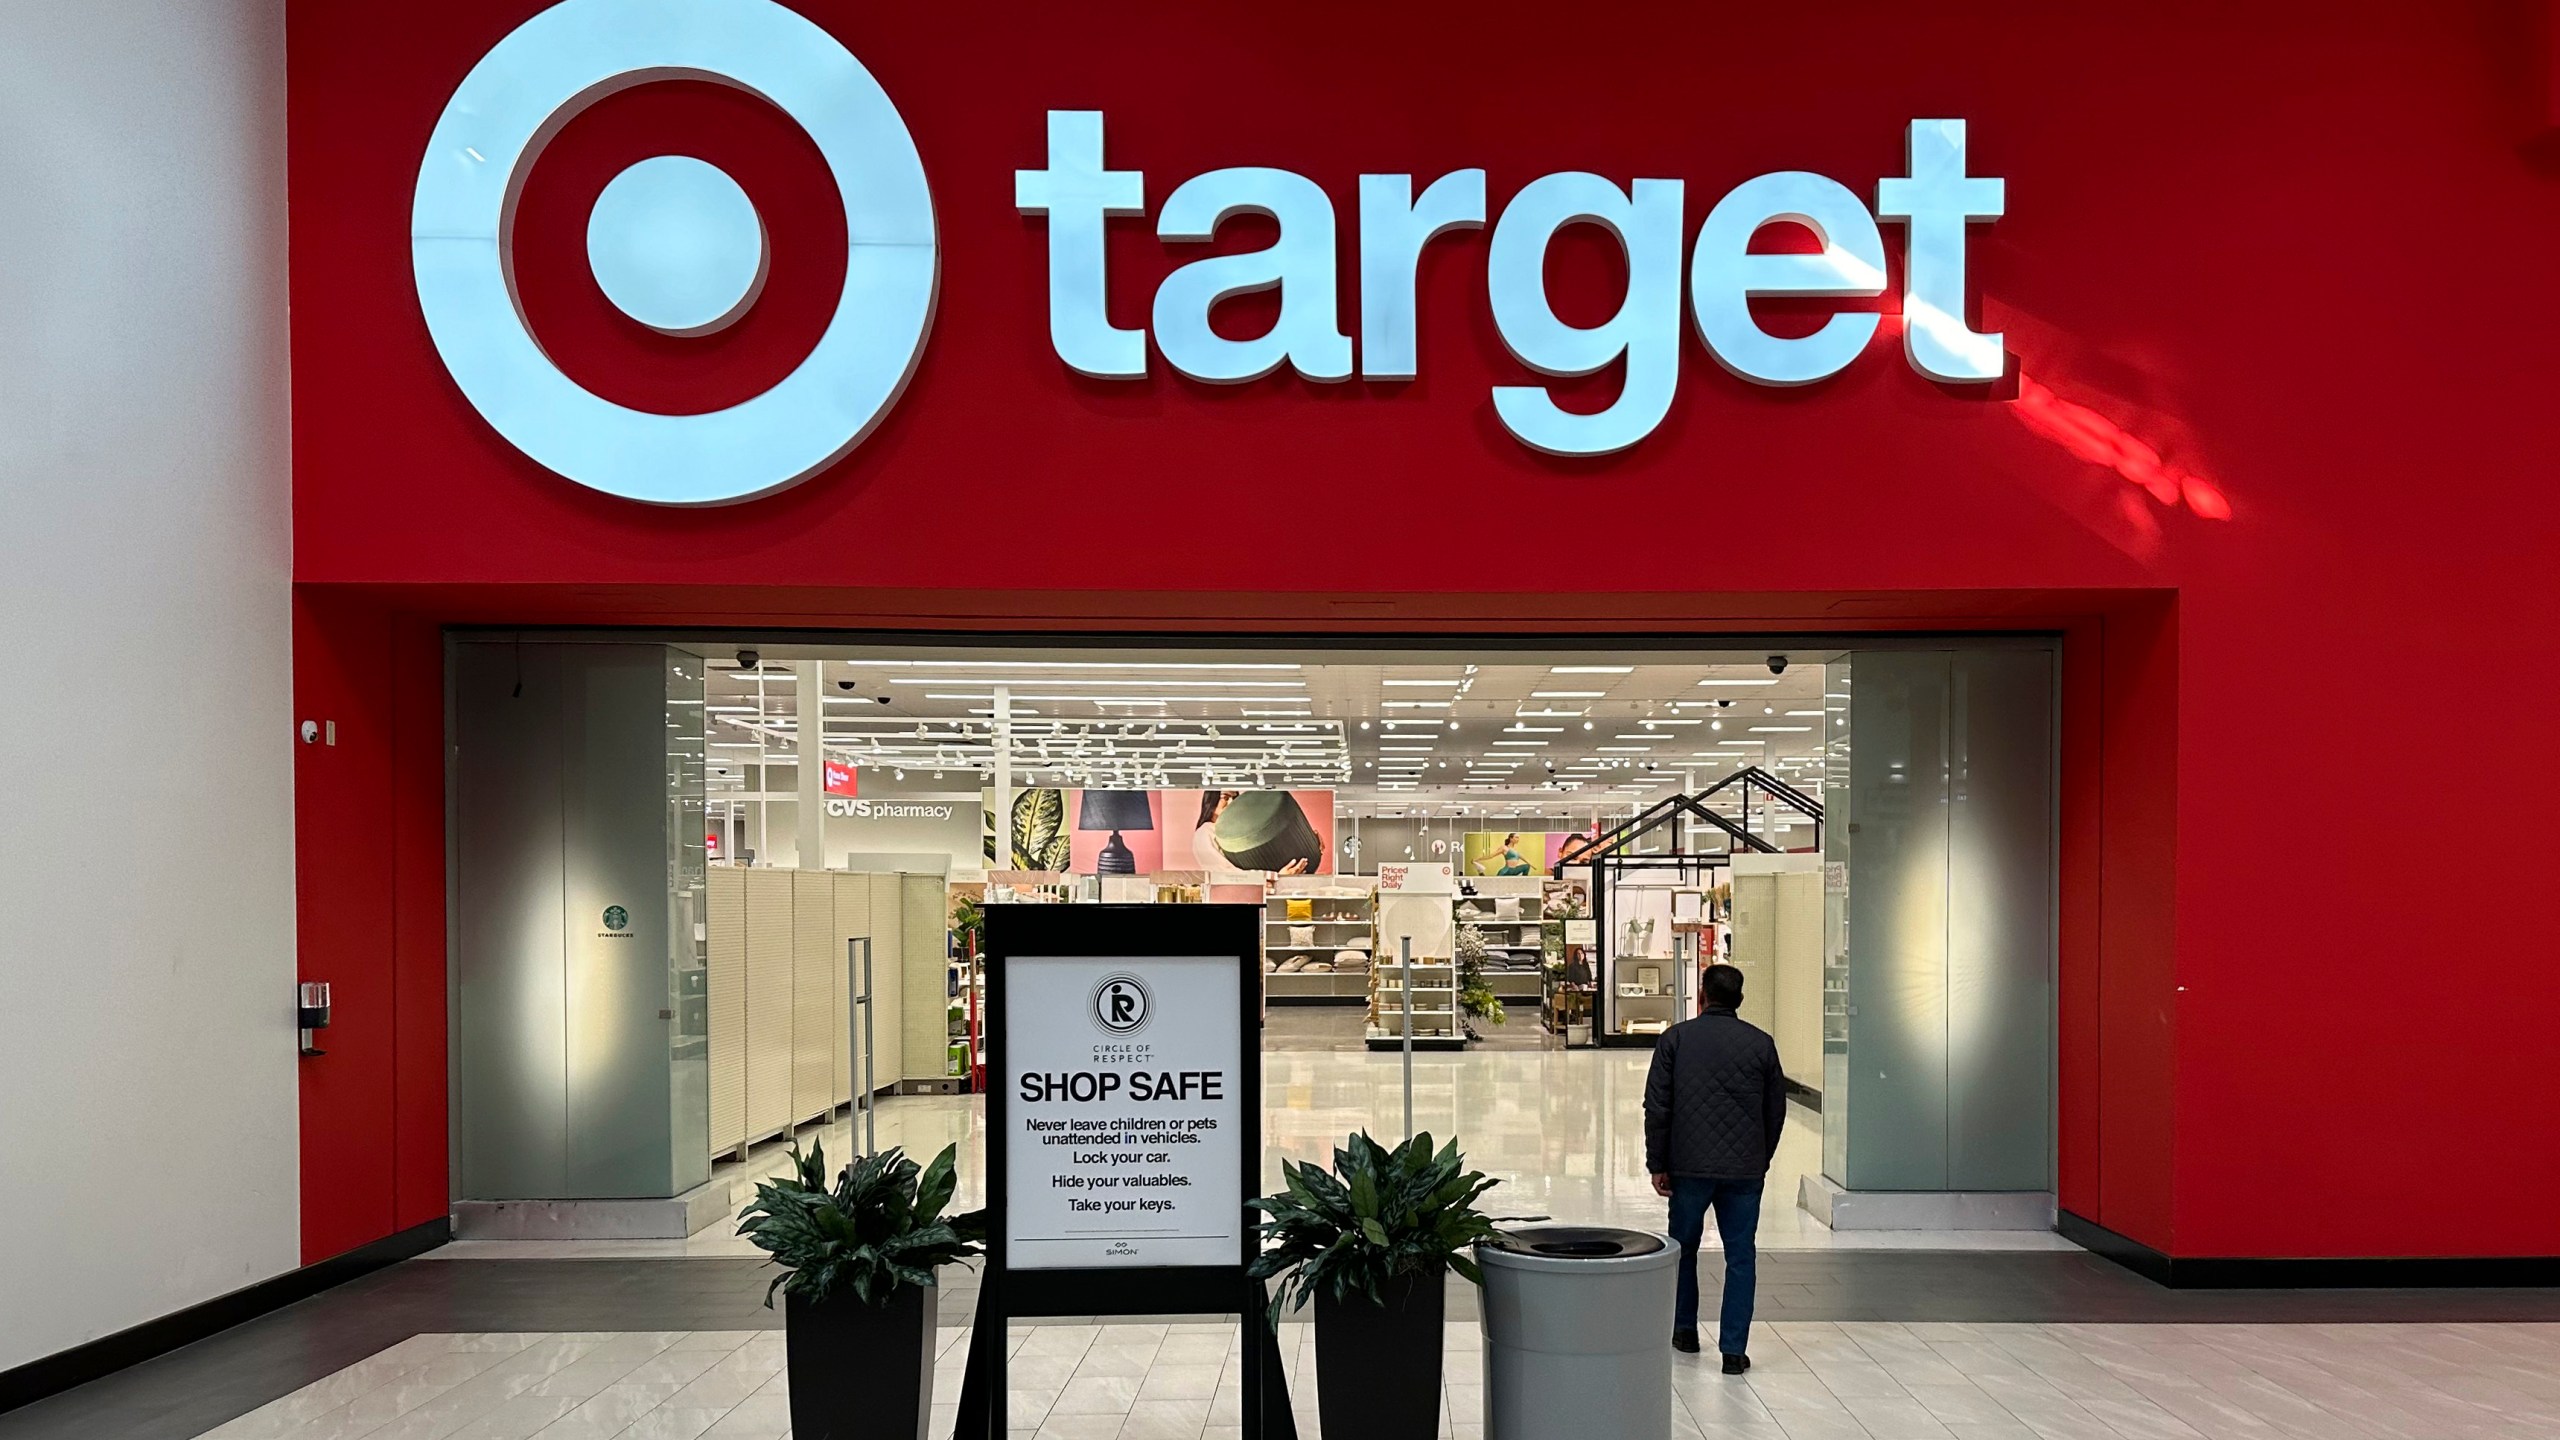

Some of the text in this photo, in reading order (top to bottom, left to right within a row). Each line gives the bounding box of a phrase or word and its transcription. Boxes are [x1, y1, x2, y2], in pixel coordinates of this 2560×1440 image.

[1015, 110, 2005, 457] target
[826, 800, 953, 820] CVS pharmacy
[1381, 866, 1408, 874] Priced
[1381, 873, 1404, 882] Right
[1381, 880, 1402, 890] Daily
[1092, 1044, 1151, 1053] CIRCLE OF
[1019, 1071, 1224, 1102] SHOP SAFE
[1026, 1117, 1218, 1132] Never leave children or pets
[1042, 1131, 1202, 1145] unattended in vehicles.
[1073, 1151, 1171, 1167] Lock your car.
[1052, 1174, 1192, 1190] Hide your valuables.
[1068, 1198, 1176, 1214] Take your keys.
[1105, 1248, 1138, 1256] SIMON
